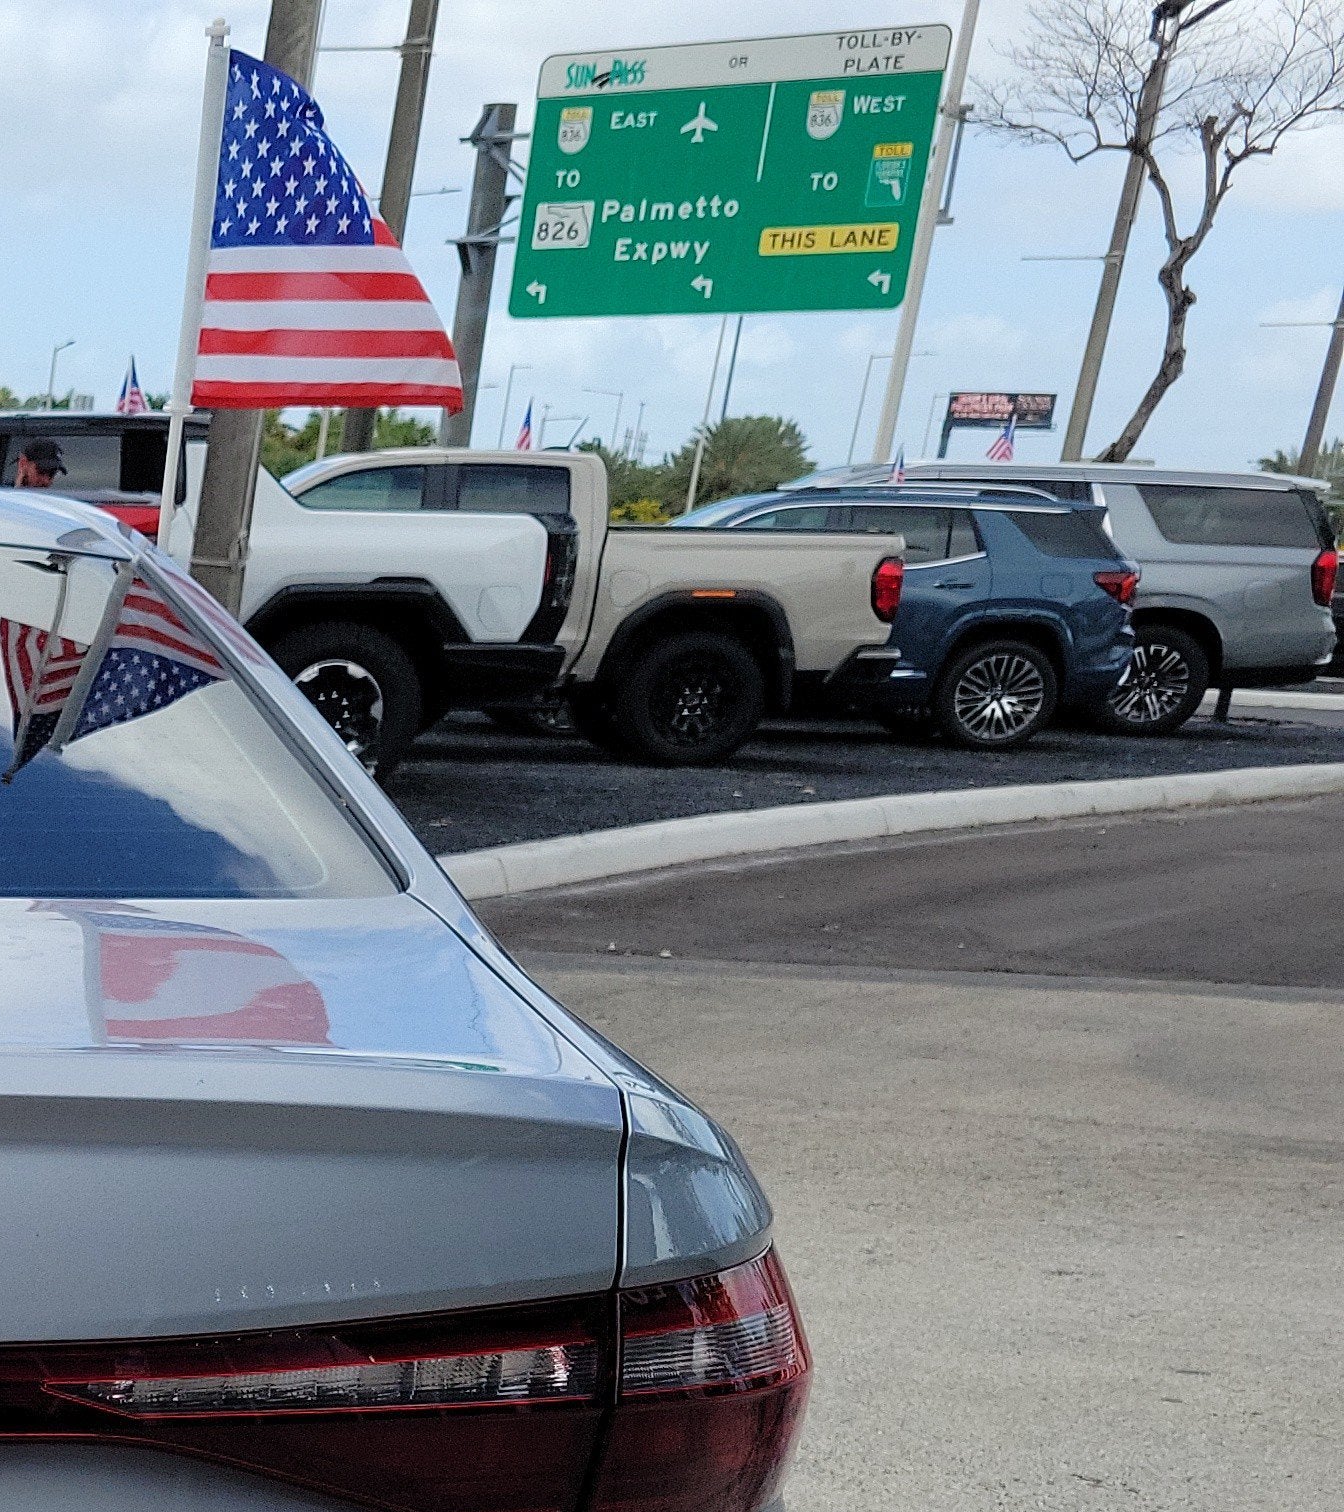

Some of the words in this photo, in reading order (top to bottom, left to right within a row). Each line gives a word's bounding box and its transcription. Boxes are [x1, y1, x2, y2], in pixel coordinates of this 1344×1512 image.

[728, 55, 749, 69] OR
[842, 55, 906, 74] PLATE
[852, 94, 907, 115] WEST
[610, 110, 659, 130] EAST
[555, 168, 581, 189] TO
[809, 170, 839, 192] TO
[601, 194, 740, 223] Palmetto
[536, 221, 580, 242] 826
[768, 232, 816, 250] THIS
[830, 228, 891, 248] LANE
[614, 236, 710, 265] Expwy
